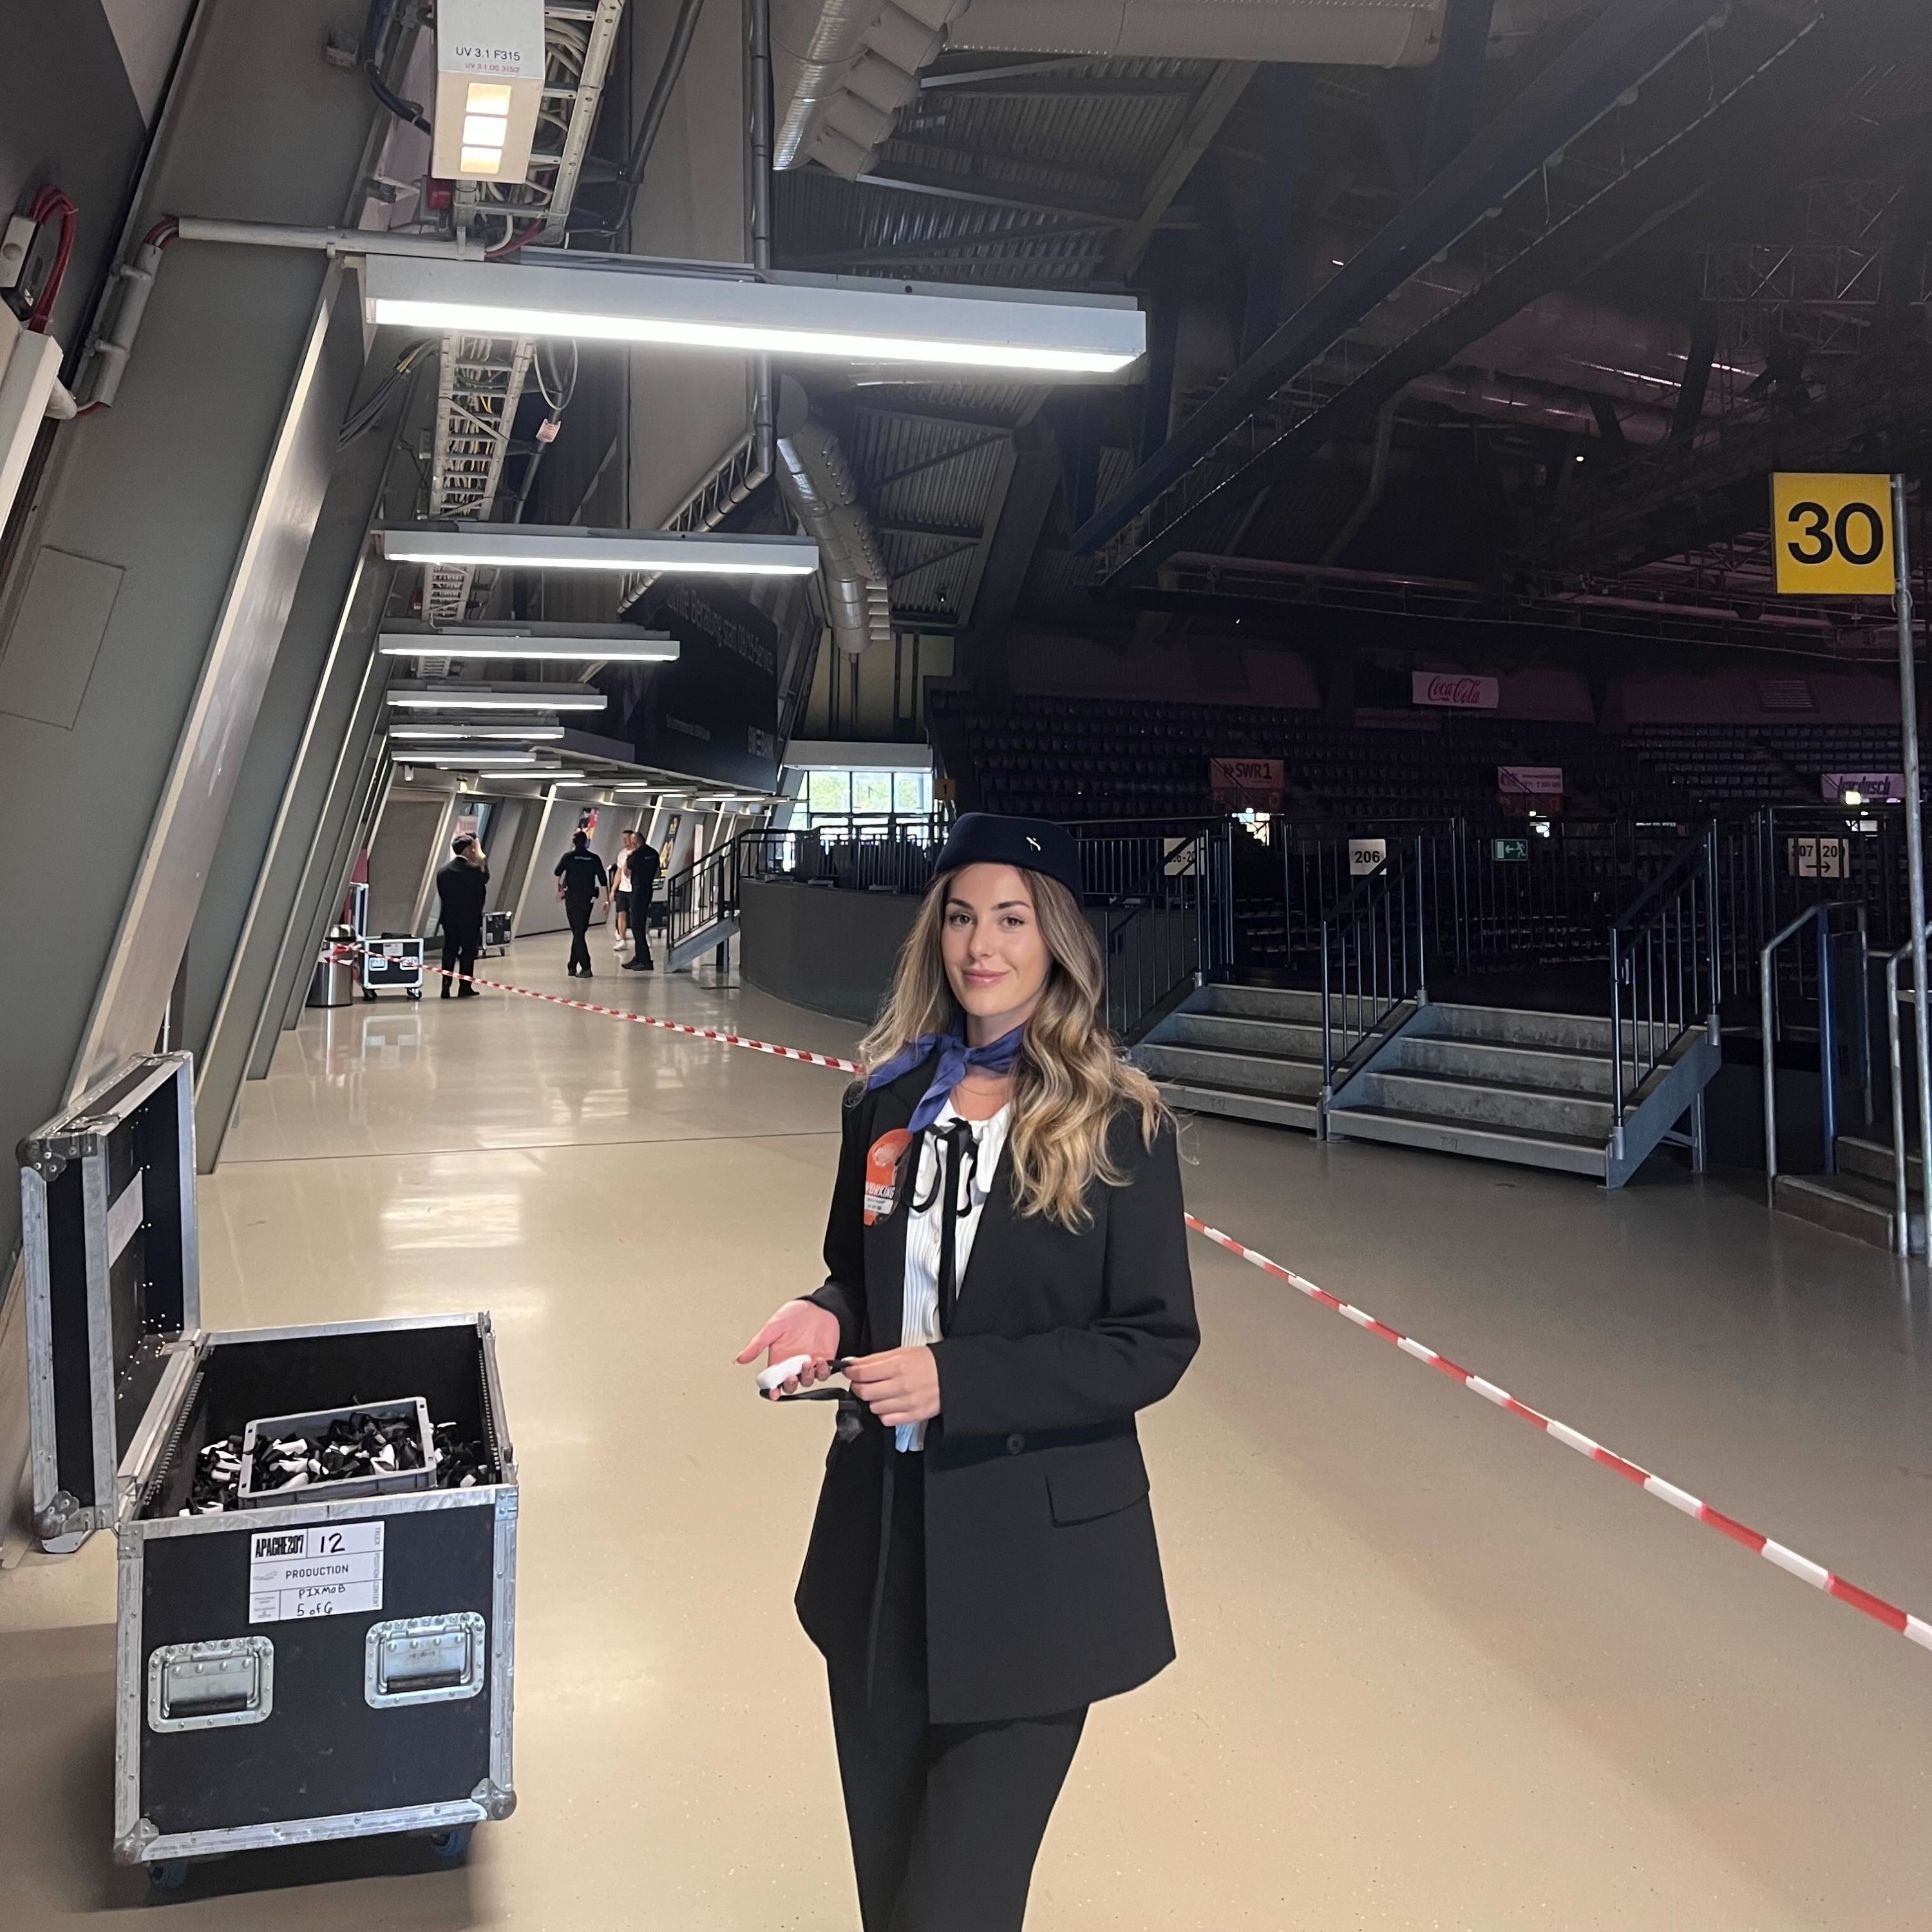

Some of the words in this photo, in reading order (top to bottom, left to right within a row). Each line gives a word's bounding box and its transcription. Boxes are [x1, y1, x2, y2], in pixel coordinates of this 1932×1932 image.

[455, 46, 472, 57] UV
[475, 48, 489, 59] 3.1
[494, 50, 520, 61] F315
[1787, 501, 1884, 565] 30
[942, 783, 947, 794] 1
[1354, 851, 1380, 863] 206
[1823, 846, 1846, 858] 20
[255, 1535, 304, 1558] APACHE207
[320, 1533, 345, 1553] 12
[285, 1564, 349, 1579] PRODUCTION
[296, 1604, 305, 1616] 5
